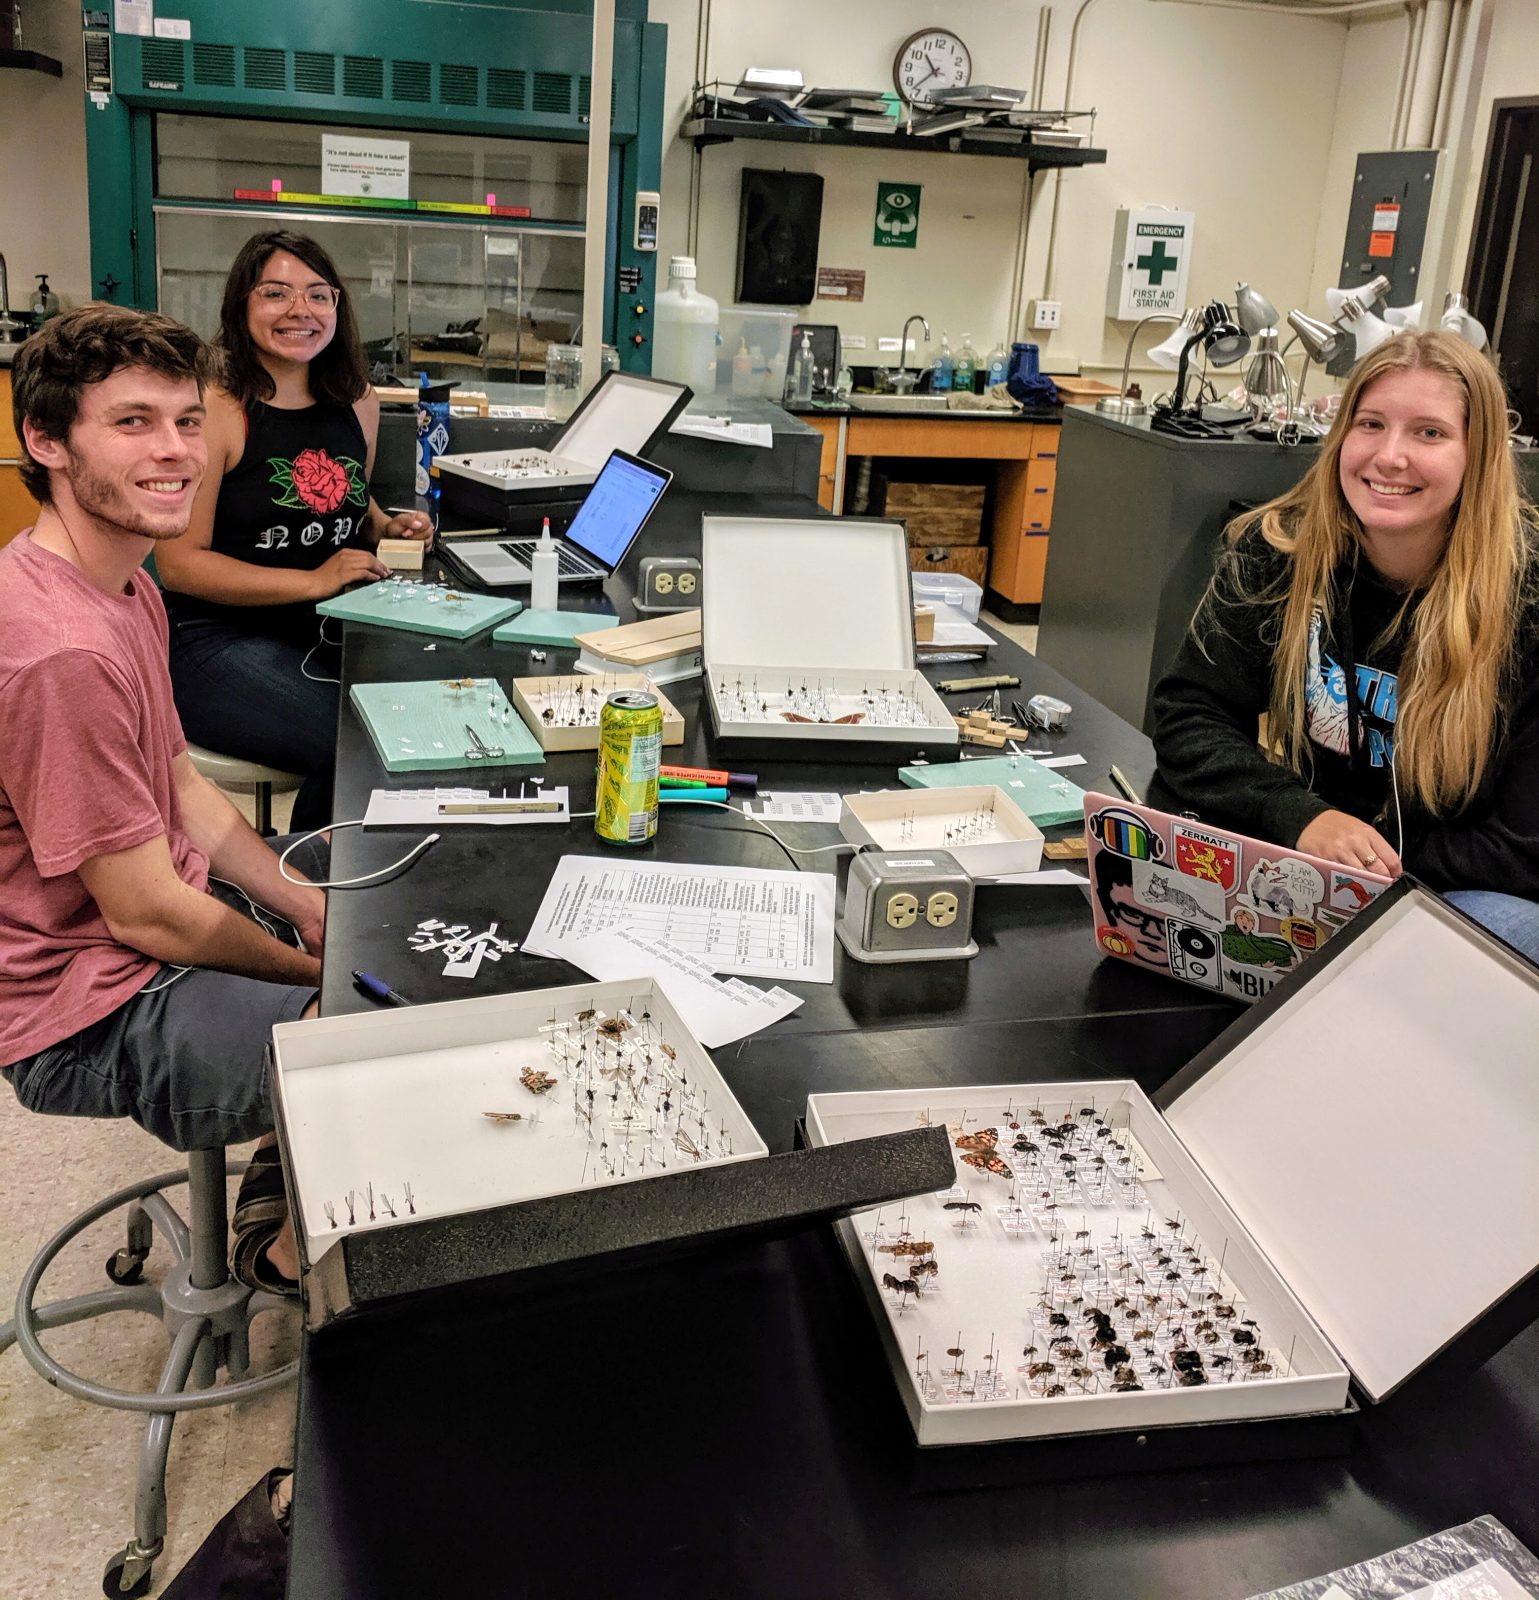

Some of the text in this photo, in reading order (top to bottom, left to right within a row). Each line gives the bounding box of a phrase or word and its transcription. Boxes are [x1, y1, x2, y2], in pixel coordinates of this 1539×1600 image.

[924, 41, 932, 51] 11
[935, 38, 946, 49] 12
[911, 49, 922, 60] 10
[950, 45, 955, 55] 1
[905, 62, 913, 72] 9
[954, 56, 963, 67] 2
[905, 76, 914, 86] 8
[955, 71, 964, 81] 3
[914, 87, 921, 97] 7
[1138, 225, 1183, 236] EMERGENCY
[1133, 289, 1175, 300] FIRST AID
[1136, 299, 1169, 308] STATION
[1181, 828, 1230, 849] ZERMATT
[1287, 862, 1311, 877] I AM
[1291, 874, 1315, 887] GOOD
[1292, 883, 1318, 898] KITTY
